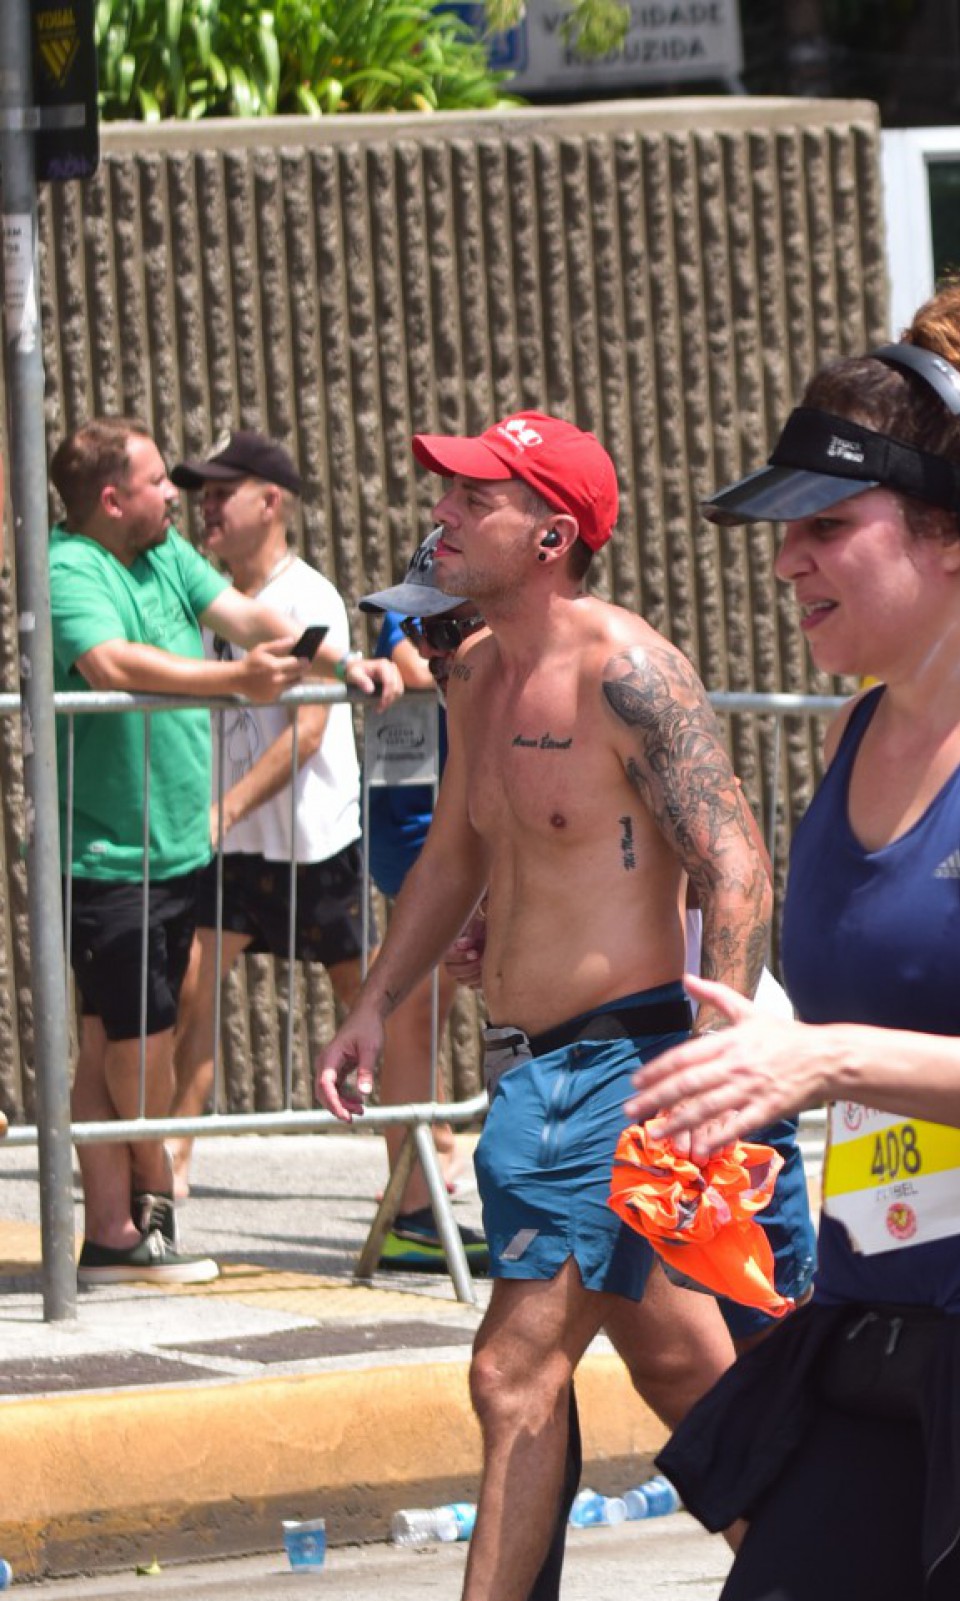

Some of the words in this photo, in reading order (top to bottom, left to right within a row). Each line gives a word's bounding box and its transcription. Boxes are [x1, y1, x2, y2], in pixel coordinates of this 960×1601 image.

[542, 2, 722, 35] VIDADE
[564, 35, 705, 67] RDUZIDA
[870, 1123, 922, 1180] 408
